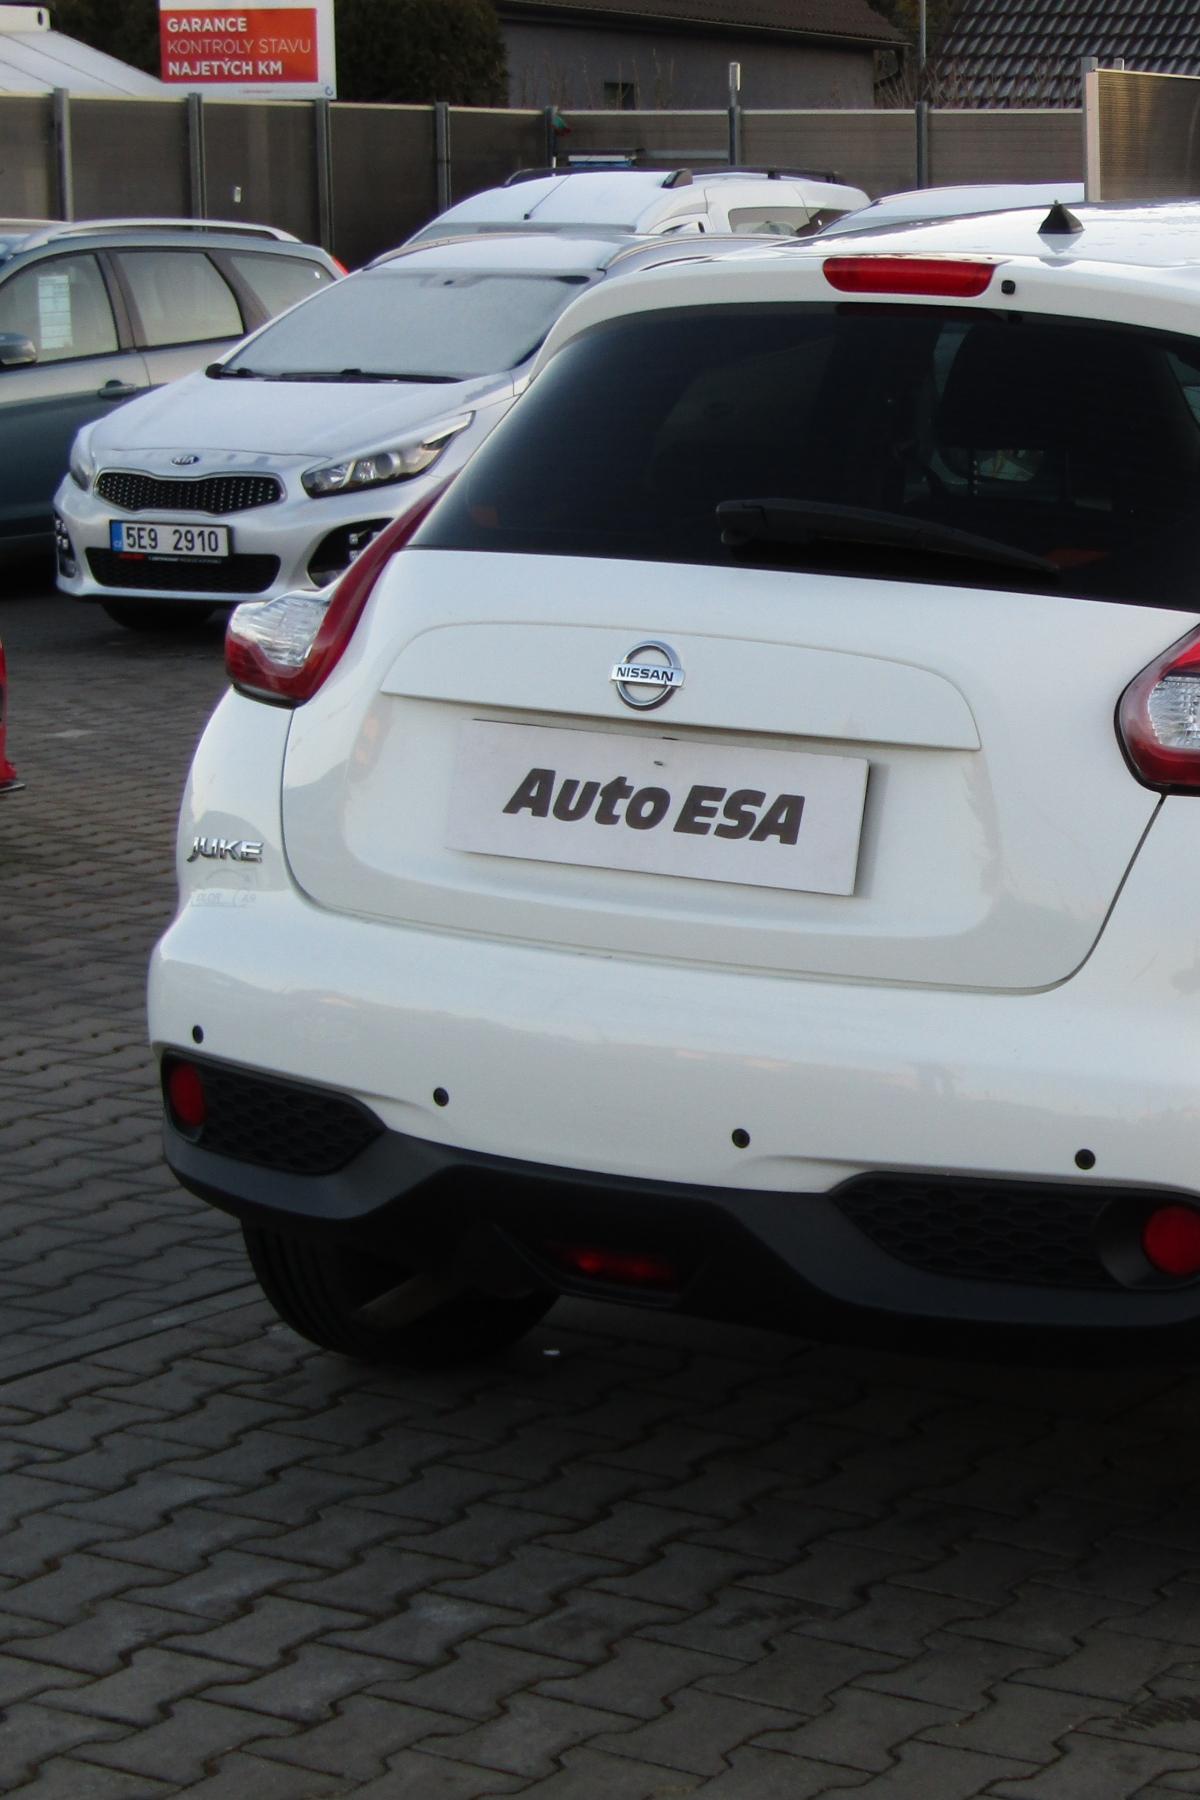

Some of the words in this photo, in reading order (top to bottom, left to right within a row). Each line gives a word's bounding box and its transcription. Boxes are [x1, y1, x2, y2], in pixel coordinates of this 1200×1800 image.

[167, 17, 248, 33] GARANCE
[167, 39, 254, 54] KONTROLY
[258, 38, 311, 54] STAVU
[168, 57, 253, 76] NAJETÝCH
[258, 61, 283, 75] KM
[126, 526, 158, 550] 5E9
[172, 529, 219, 553] 2910
[616, 666, 674, 682] NISSAN
[502, 767, 671, 830] Auto
[672, 784, 806, 846] ESA
[186, 836, 264, 864] JUKE
